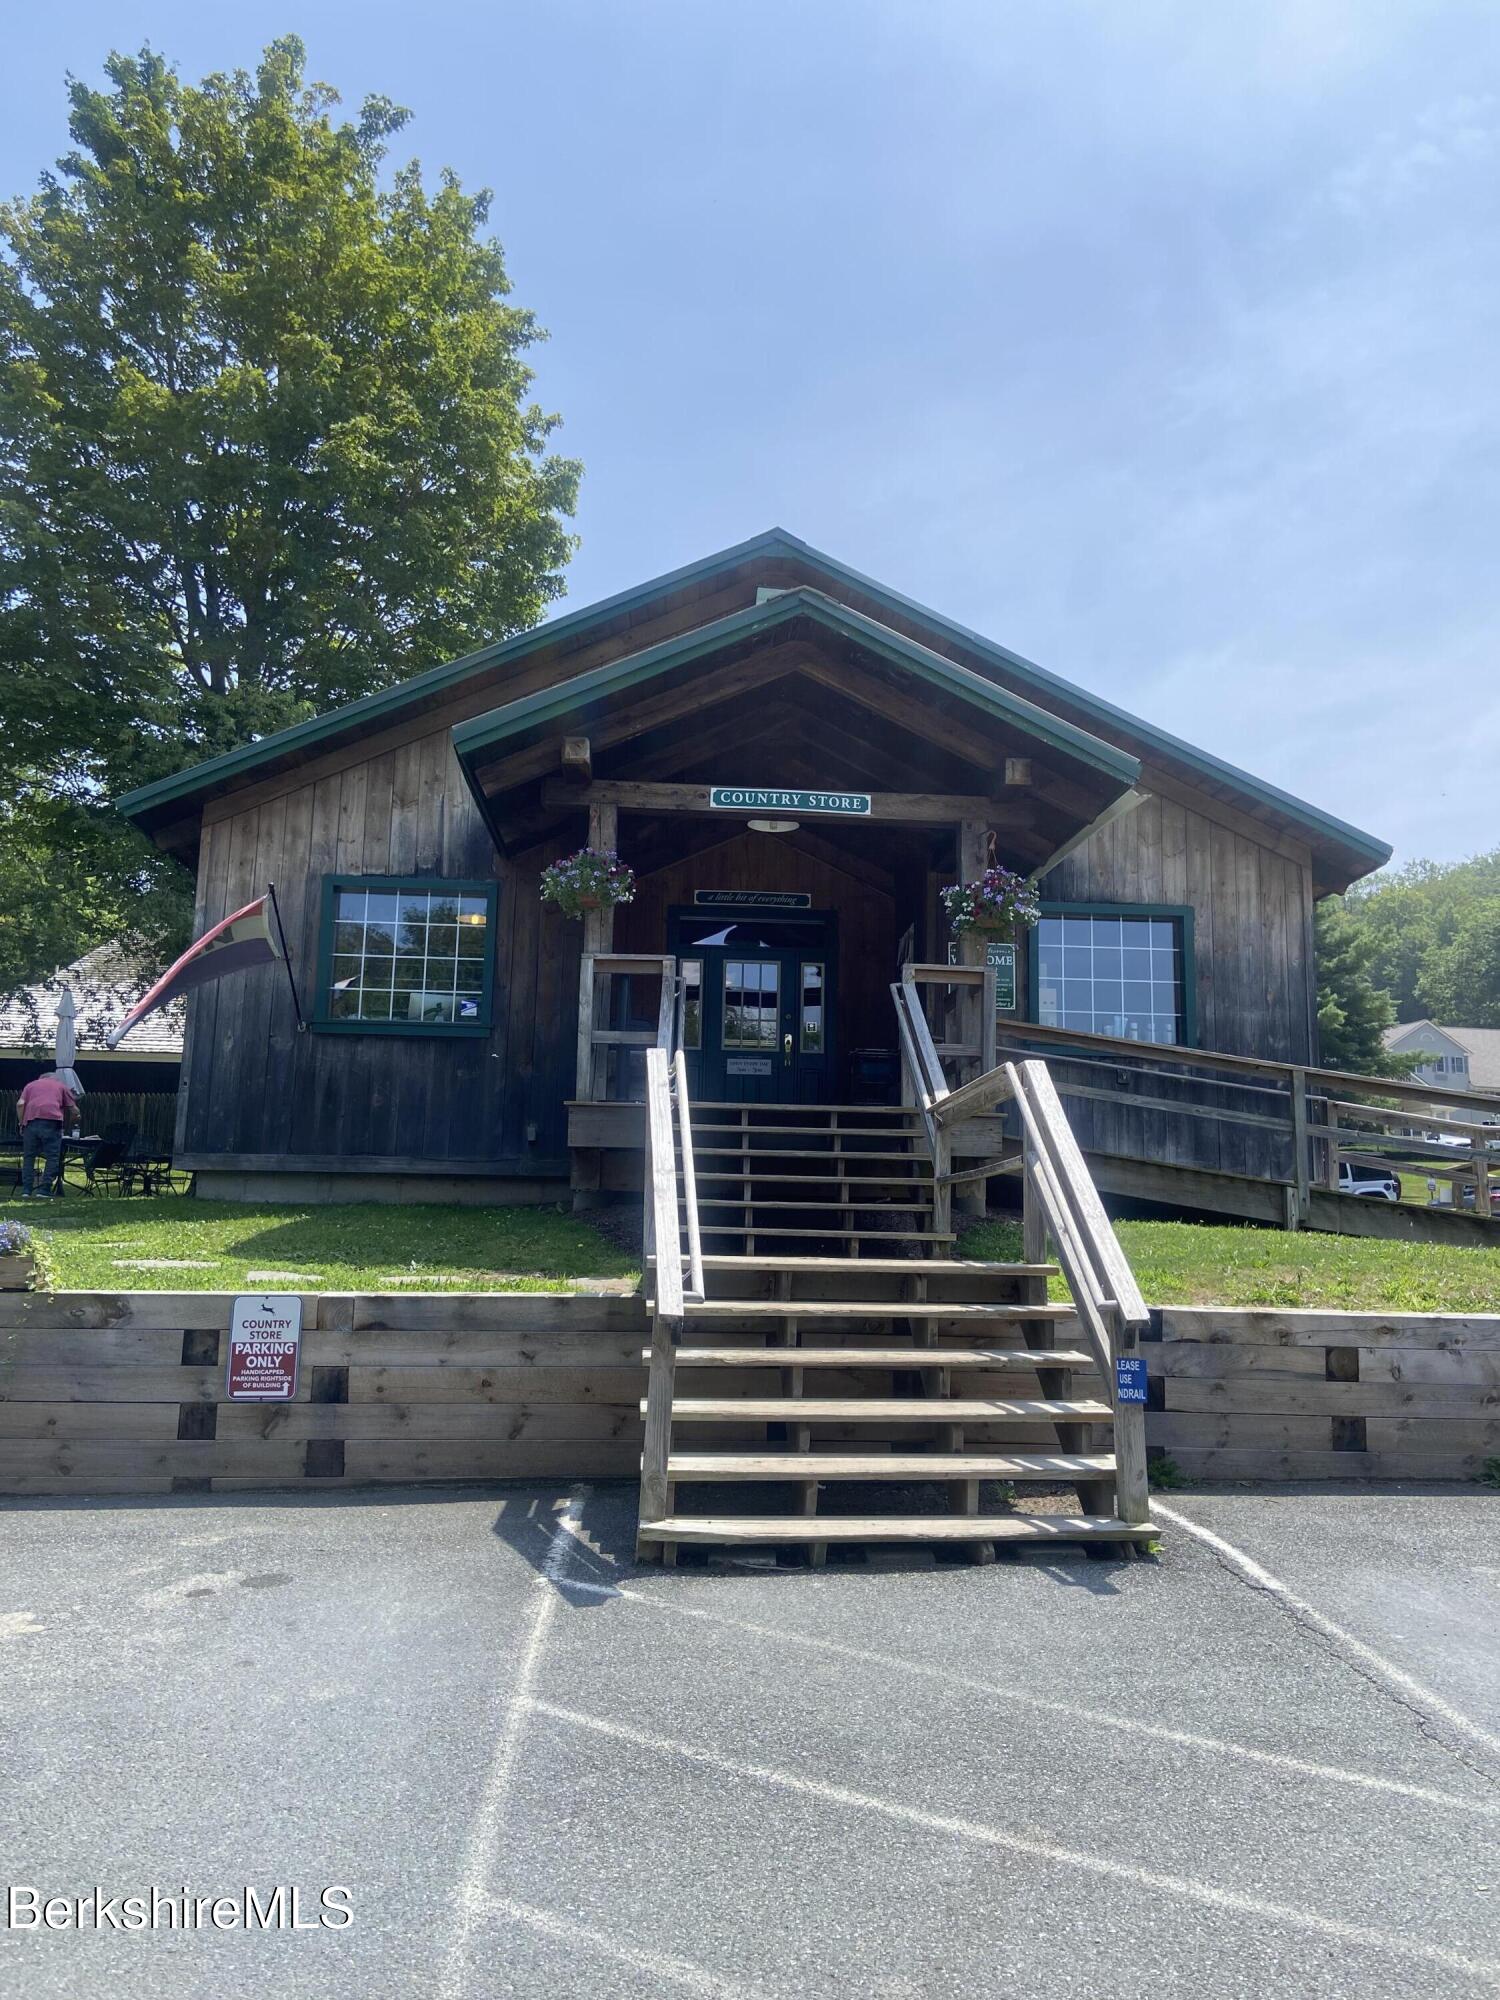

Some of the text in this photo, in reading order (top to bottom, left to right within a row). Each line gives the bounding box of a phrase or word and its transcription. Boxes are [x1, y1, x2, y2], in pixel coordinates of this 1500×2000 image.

[720, 791, 862, 809] COUNTRY STORE
[715, 892, 733, 901] little
[735, 892, 747, 902] bit
[758, 894, 798, 905] everything
[242, 1320, 292, 1329] COUNTRY
[249, 1331, 282, 1340] STORE
[235, 1343, 294, 1355] PARKING
[246, 1356, 282, 1368] ONLY
[1116, 1360, 1141, 1371] LEASE
[1119, 1373, 1132, 1384] USE
[1117, 1388, 1146, 1400] NDRAIL
